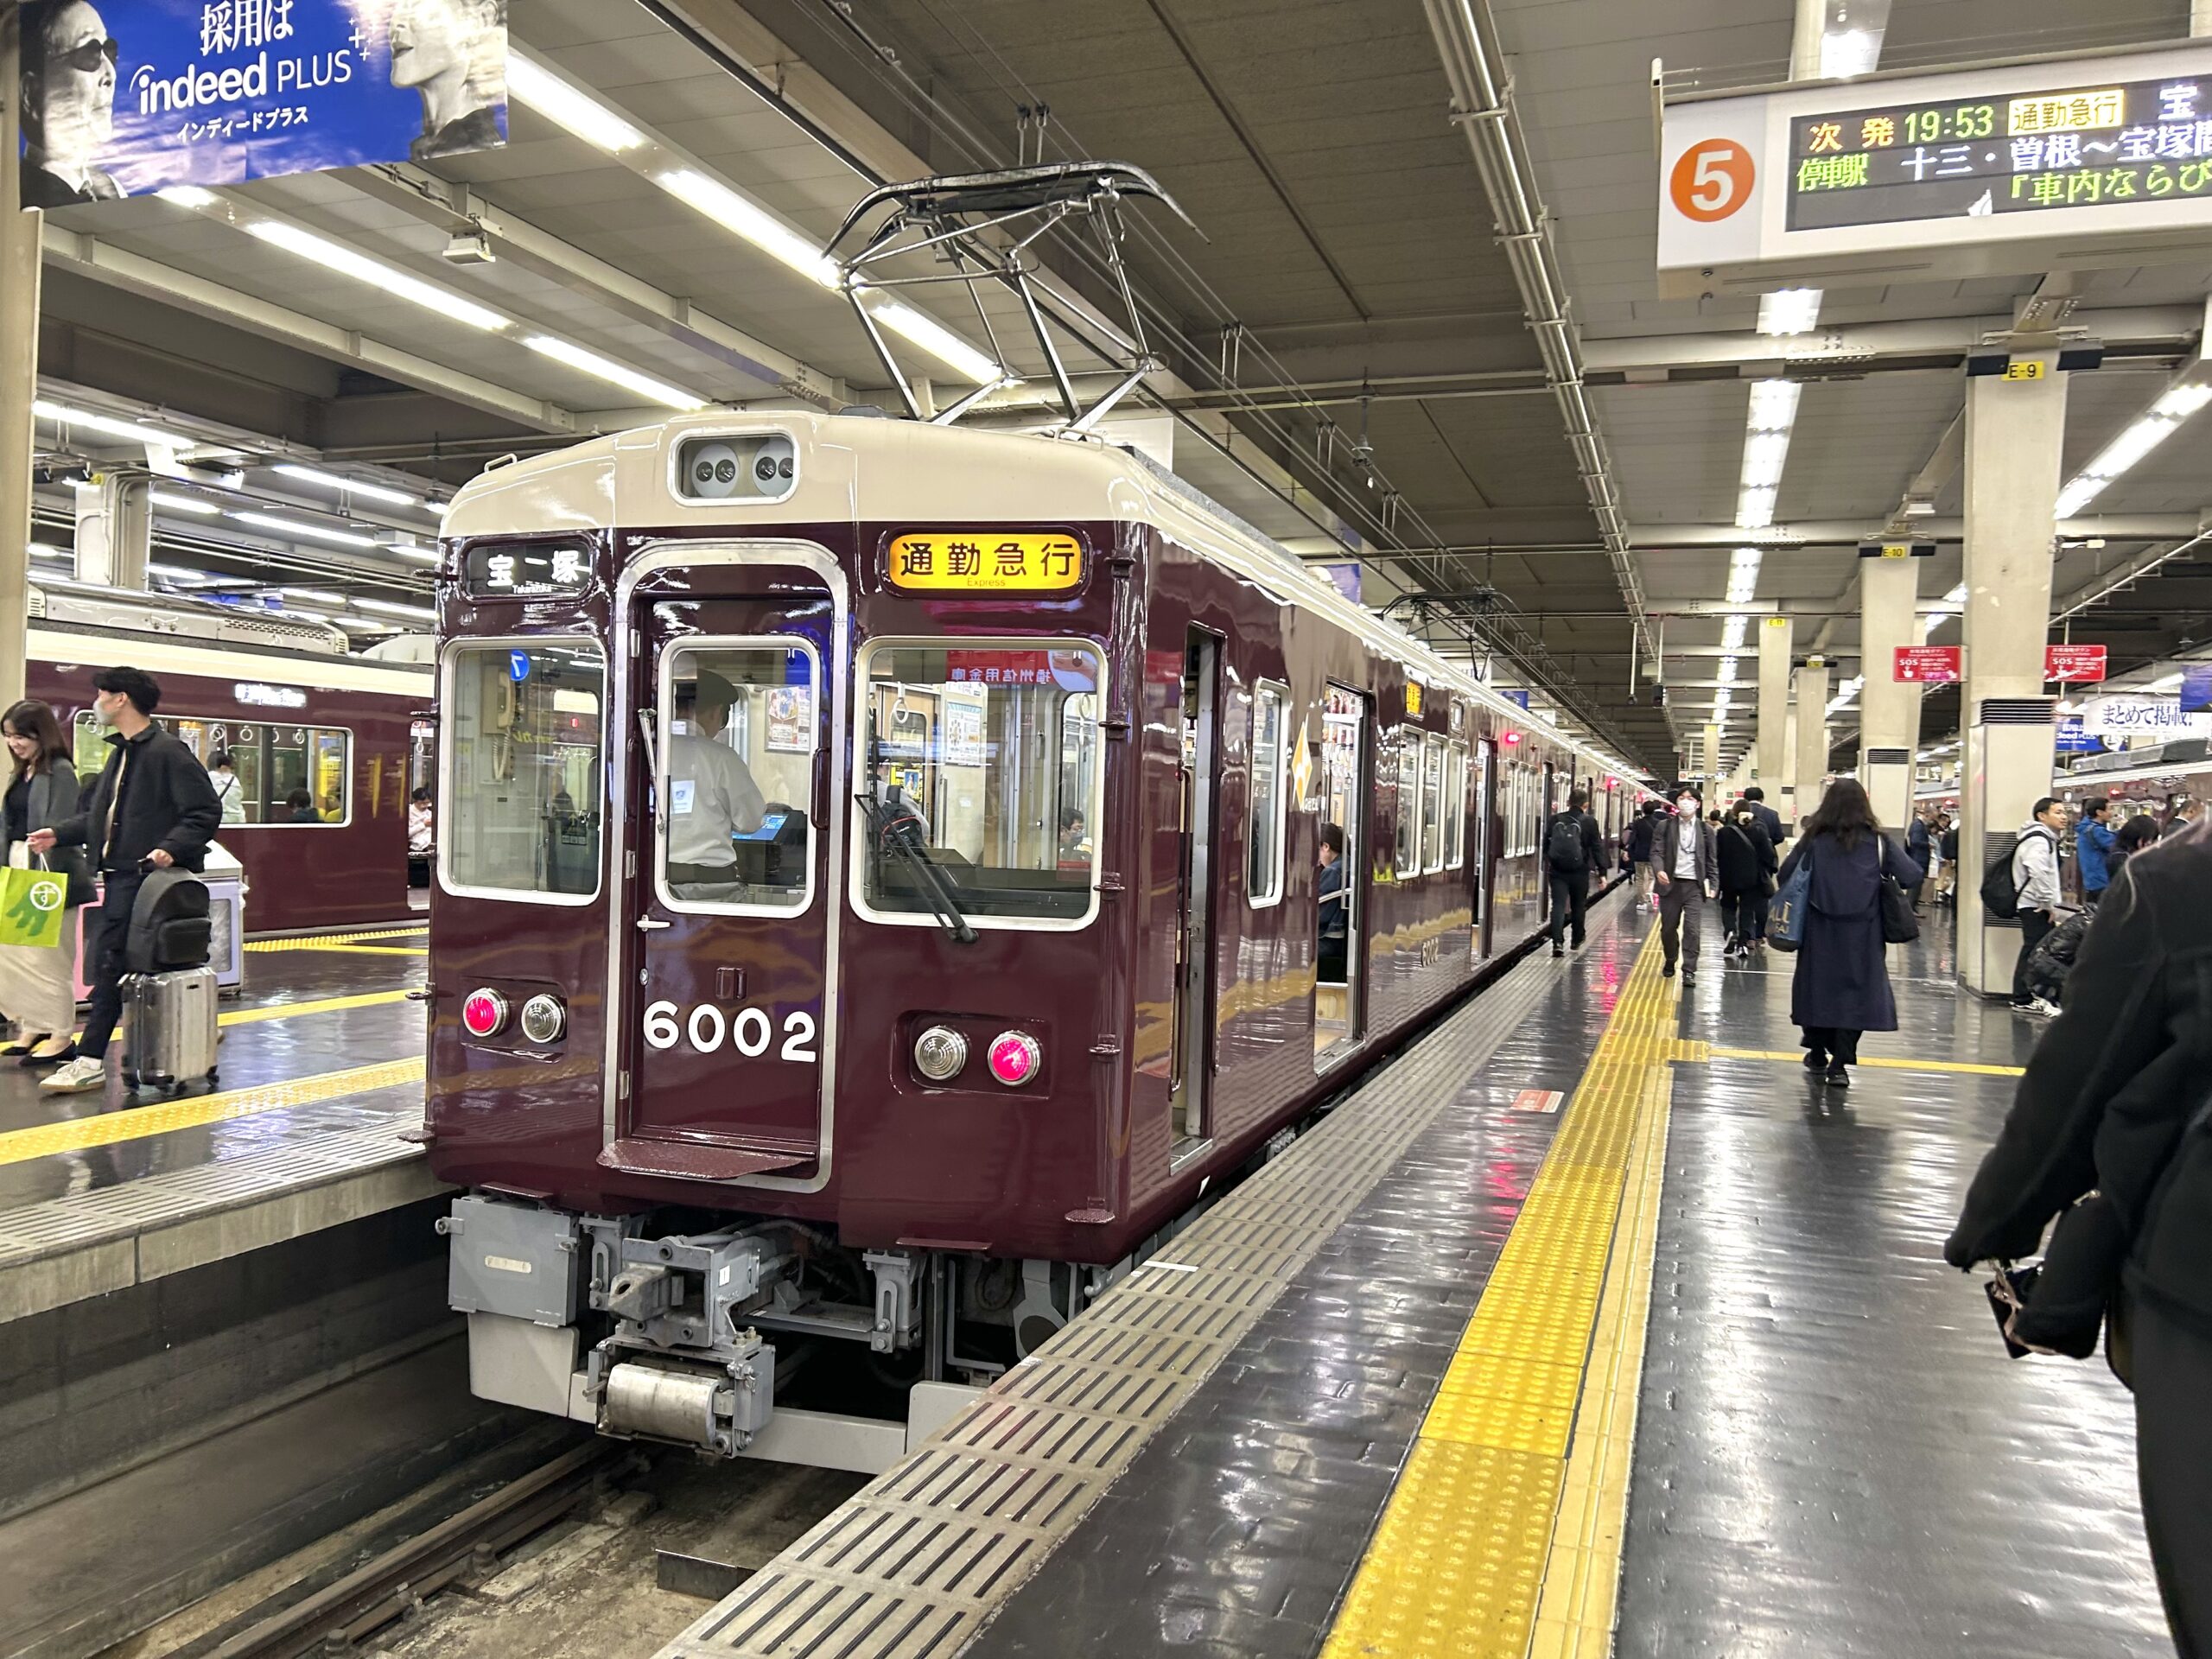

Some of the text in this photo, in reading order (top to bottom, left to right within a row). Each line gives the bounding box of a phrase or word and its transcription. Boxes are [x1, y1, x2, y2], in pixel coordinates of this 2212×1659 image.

[200, 0, 294, 56] 採用は
[130, 49, 352, 115] indeed PLUS
[176, 106, 308, 143] インディードプラス
[1904, 105, 1994, 144] 19:53
[2013, 95, 2117, 131] 通勤急行
[2158, 84, 2198, 120] 宝
[1691, 149, 1733, 212] 5
[1796, 153, 1869, 192] 停車駅
[2009, 364, 2037, 378] E-9
[486, 550, 580, 588] 宝塚
[899, 542, 1075, 577] 通勤急行
[1883, 548, 1903, 557] E-10
[967, 577, 1006, 587] Express
[643, 1000, 817, 1063] 6002
